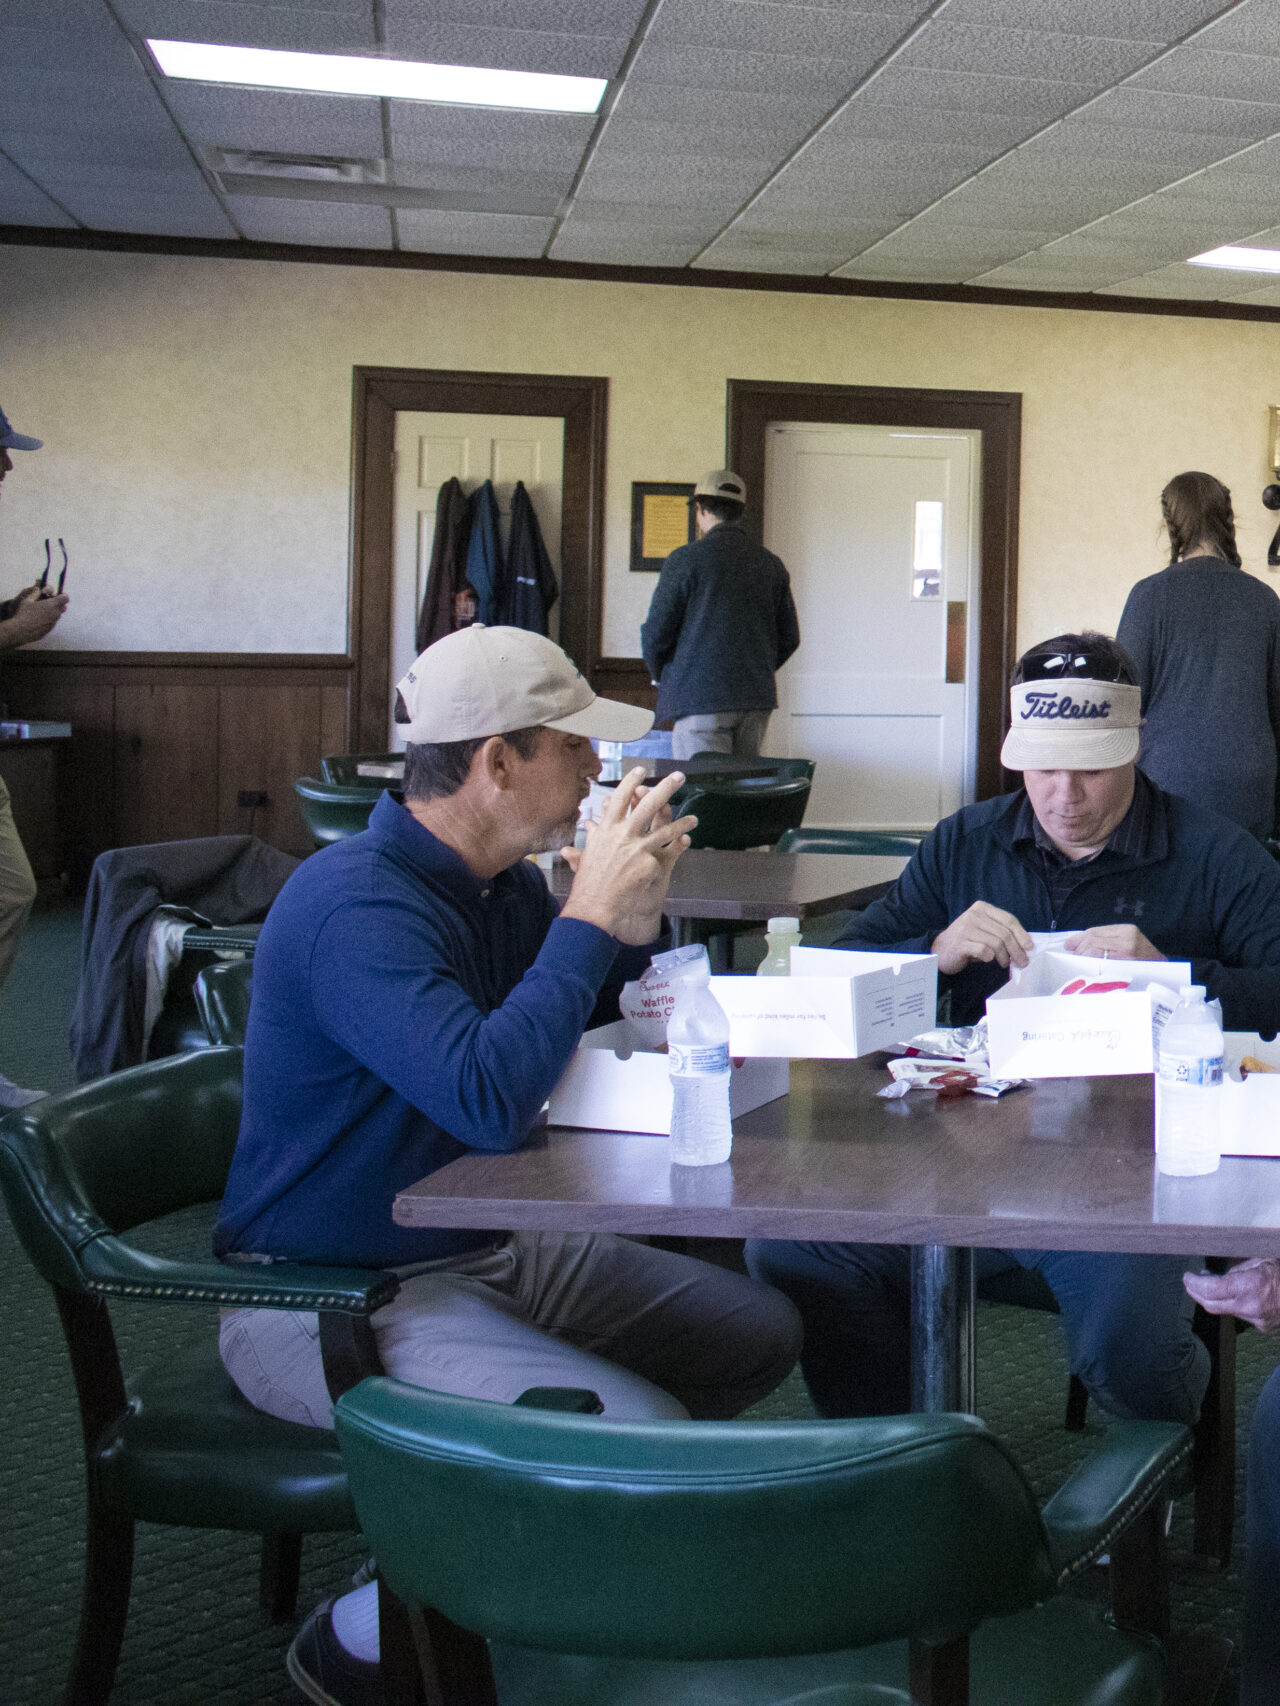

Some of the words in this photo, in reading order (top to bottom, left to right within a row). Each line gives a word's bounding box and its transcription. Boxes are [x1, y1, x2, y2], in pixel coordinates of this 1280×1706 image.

[1020, 692, 1112, 720] Titleist
[641, 996, 675, 1008] Waffle
[631, 1009, 662, 1019] Potato
